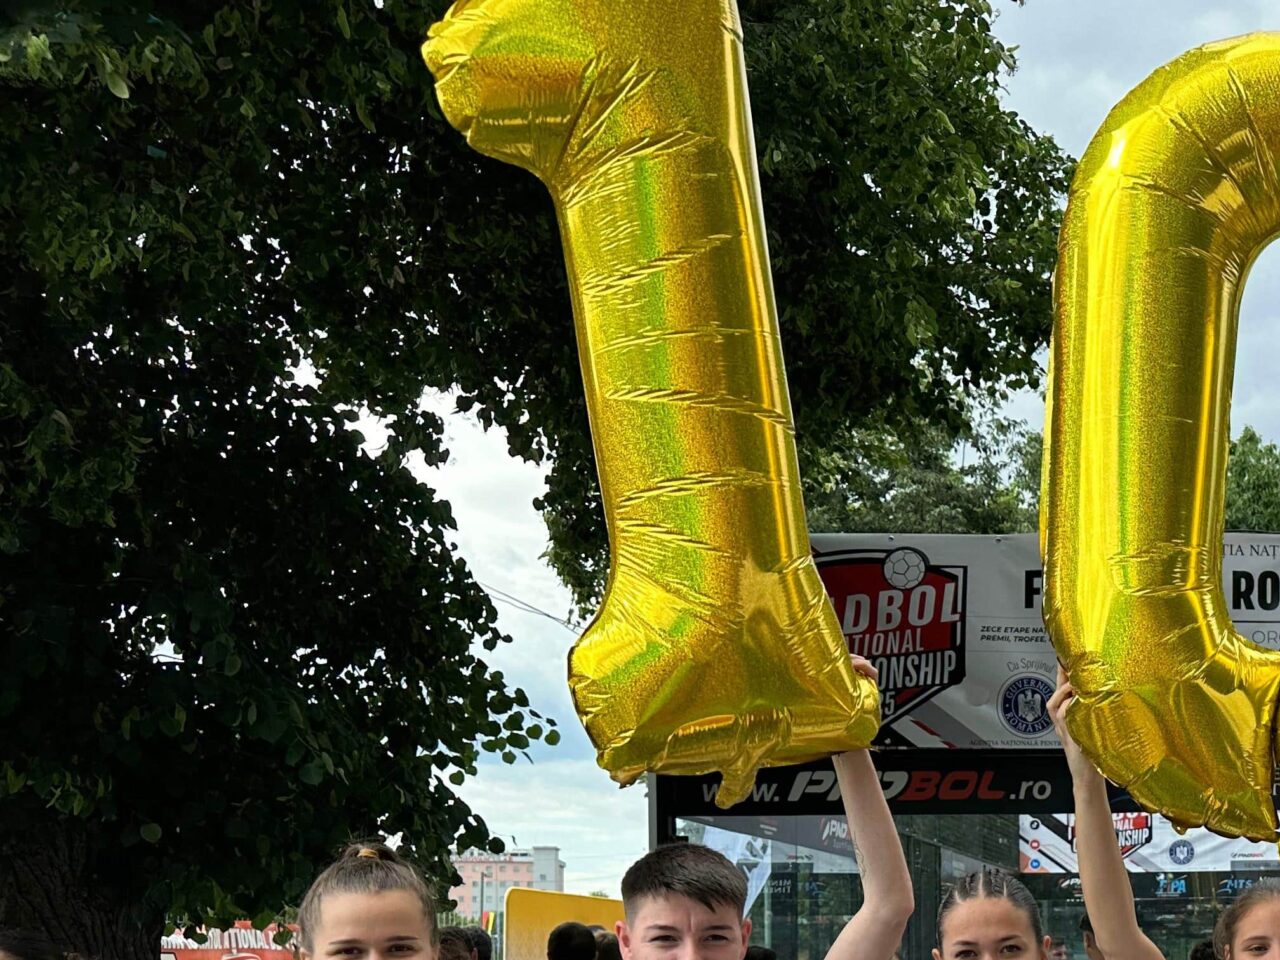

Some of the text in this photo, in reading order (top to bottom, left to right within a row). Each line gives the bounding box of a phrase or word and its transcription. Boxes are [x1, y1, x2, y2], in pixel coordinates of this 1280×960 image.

[830, 583, 961, 635] DBOL
[846, 628, 925, 657] TIONAL
[874, 650, 957, 699] ONSHIP
[1006, 661, 1019, 672] Cu
[702, 783, 779, 802] ww.
[787, 770, 1005, 801] PDBOL
